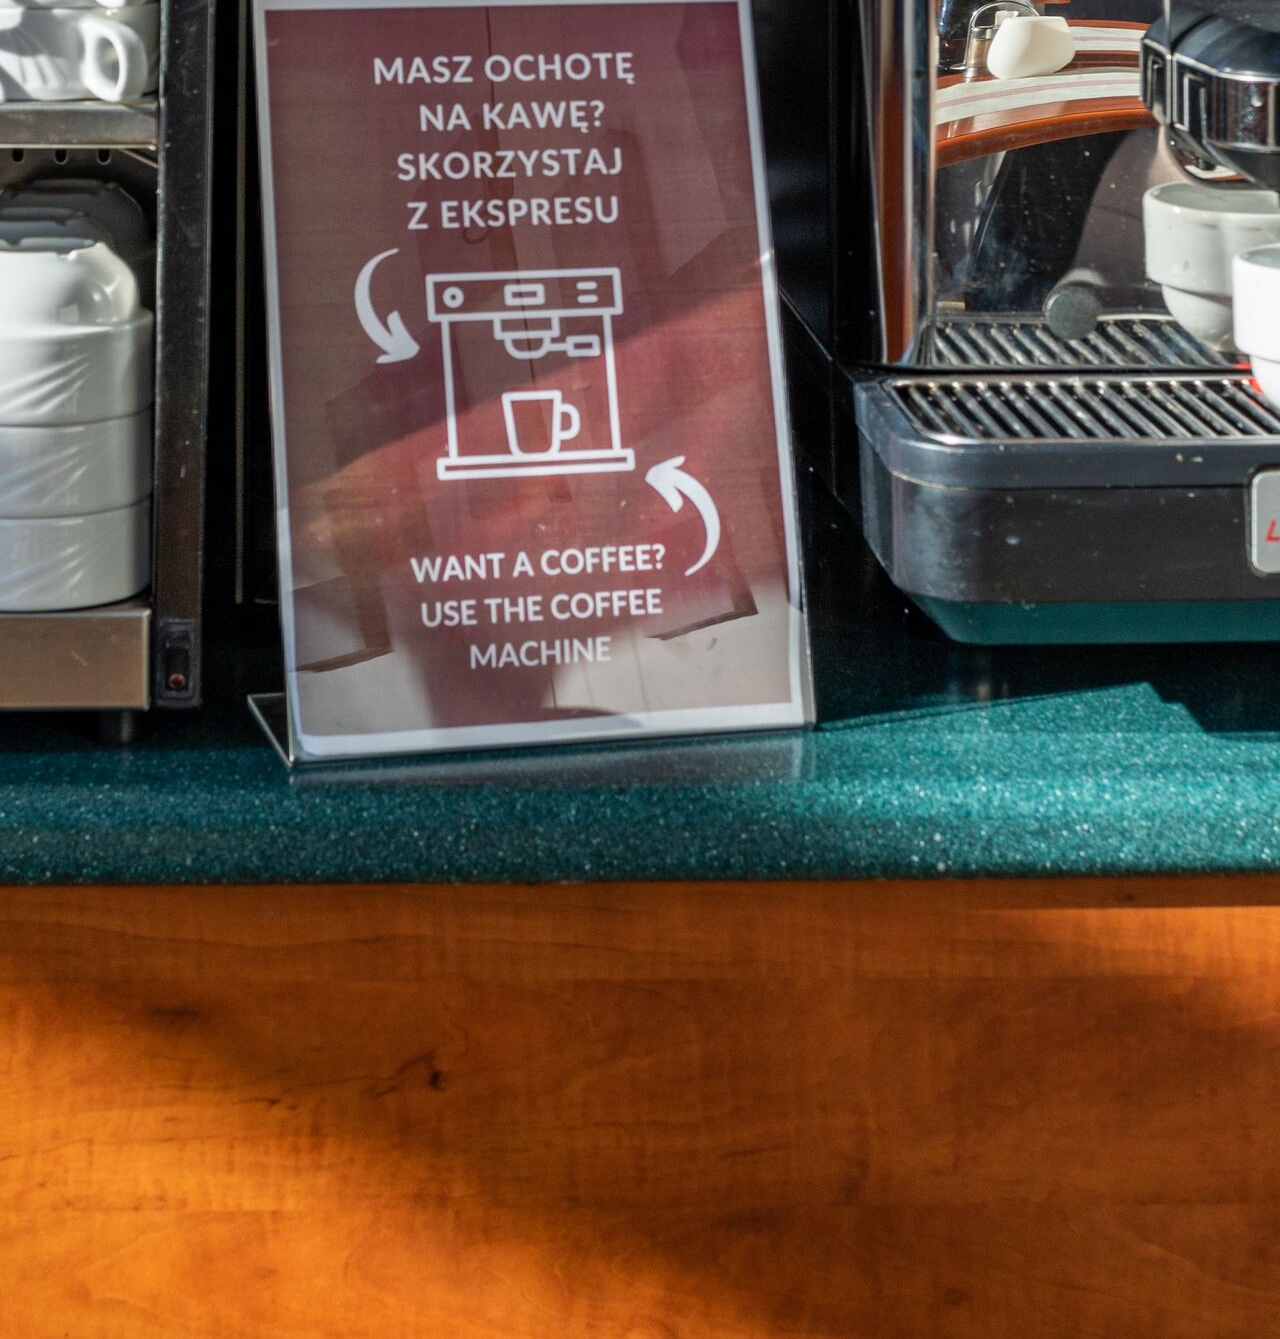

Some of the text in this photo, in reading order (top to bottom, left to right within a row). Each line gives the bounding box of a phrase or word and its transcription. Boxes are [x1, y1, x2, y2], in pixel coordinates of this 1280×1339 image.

[373, 51, 635, 85] MASZ OCHOTĘ
[419, 100, 605, 133] NA KAWĘ?
[397, 147, 623, 181] SKORZYSTAJ
[407, 195, 619, 230] Z EKSPRESU
[410, 543, 666, 584] WANT A COFFEE?
[421, 588, 663, 627] USE THE COFFEE
[470, 636, 612, 670] MACHINE
